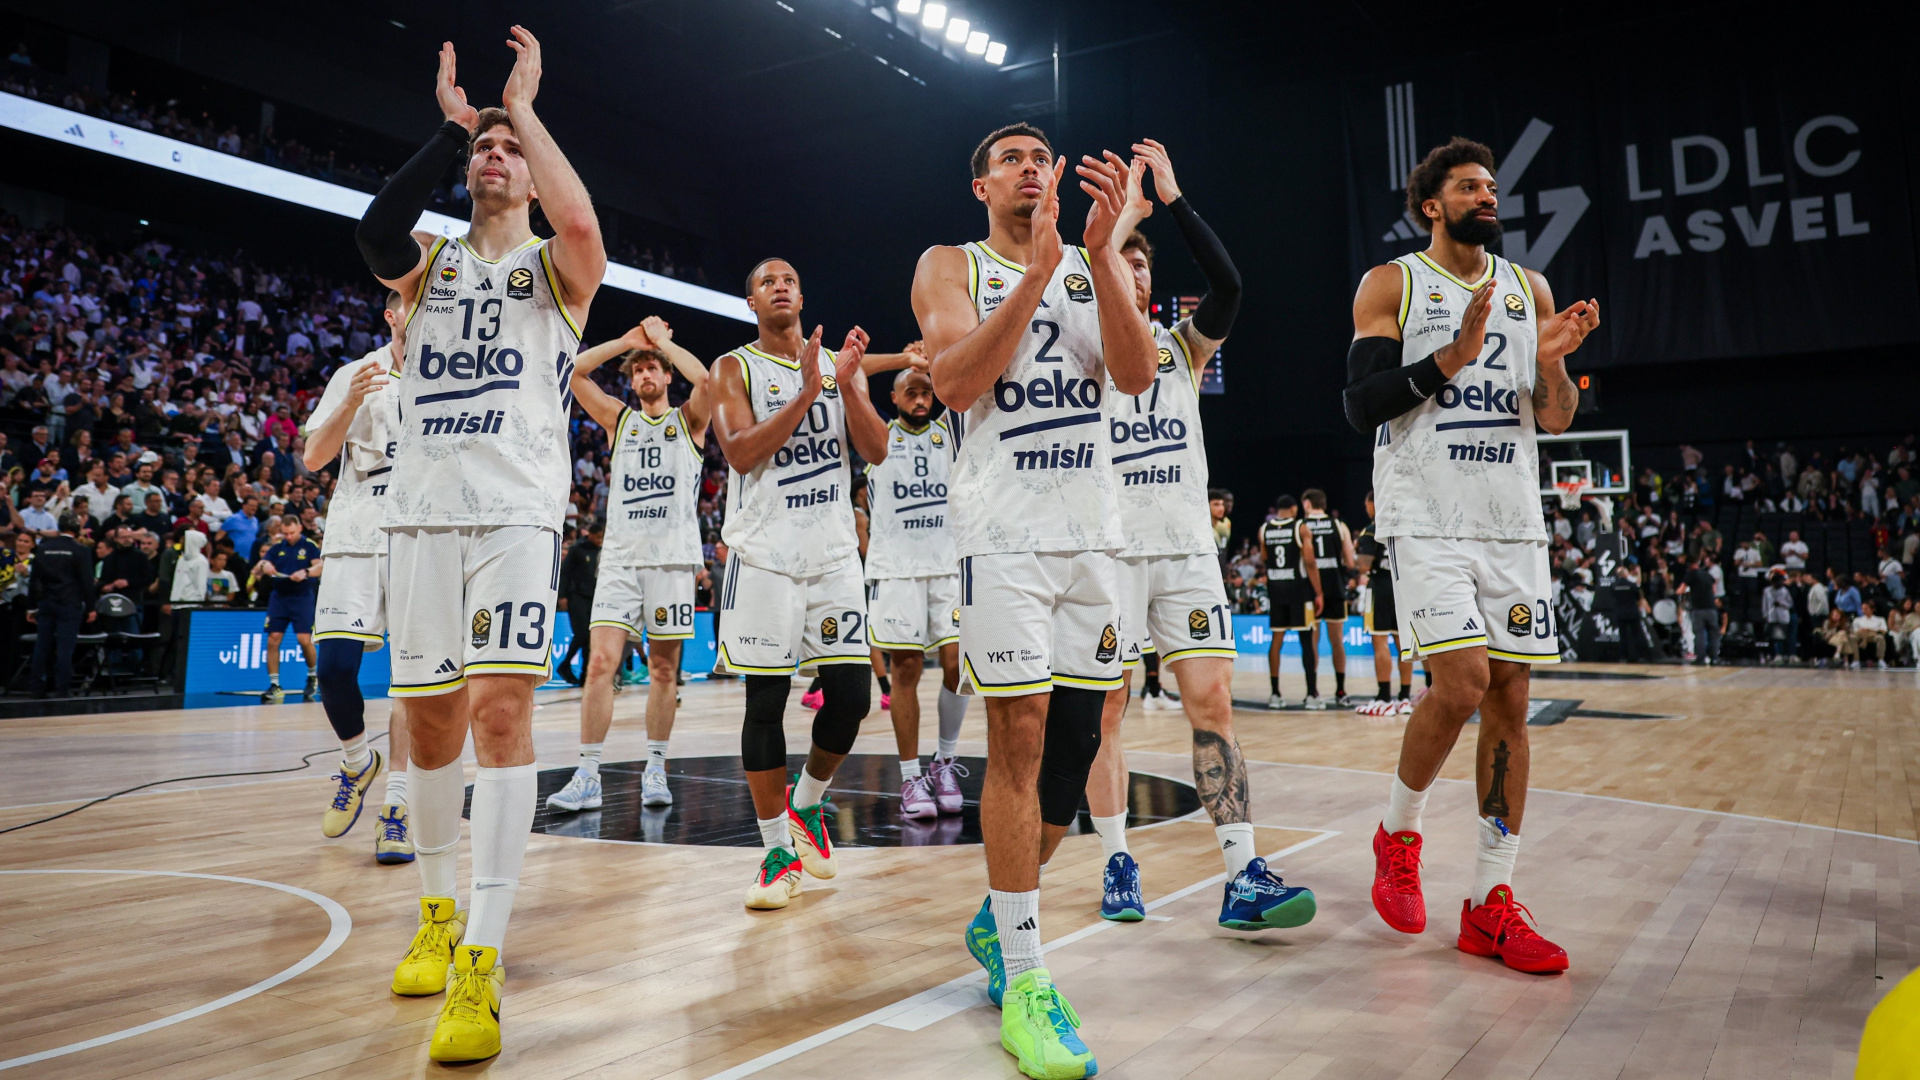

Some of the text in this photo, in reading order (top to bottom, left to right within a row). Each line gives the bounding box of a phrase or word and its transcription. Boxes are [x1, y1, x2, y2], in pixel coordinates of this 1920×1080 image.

[1625, 115, 1861, 201] LDLC
[1634, 192, 1869, 259] ASVEL
[430, 286, 457, 297] beko
[984, 295, 1005, 305] bek
[425, 304, 455, 314] RAMS
[458, 298, 503, 342] 13
[1426, 307, 1450, 316] beko
[1423, 324, 1451, 334] RAMS
[1031, 319, 1063, 362] 2
[419, 344, 524, 380] beko
[994, 369, 1102, 412] beko
[1579, 375, 1590, 389] 0
[767, 399, 786, 408] beko
[421, 409, 505, 435] misli
[1110, 414, 1187, 443] beko
[638, 446, 661, 469] 18
[1013, 442, 1095, 471] misli
[1448, 441, 1516, 464] misli
[914, 456, 929, 477] 8
[1122, 465, 1181, 487] misli
[623, 473, 675, 492] beko
[893, 480, 947, 500] beko
[785, 484, 839, 509] misli
[628, 506, 667, 520] misli
[903, 515, 943, 529] misli
[1275, 545, 1286, 569] 3
[1315, 535, 1325, 558] 1
[669, 603, 692, 627] 18
[1412, 609, 1425, 619] YKT
[494, 601, 546, 650] 13
[739, 636, 757, 645] YKT
[987, 650, 1014, 663] YKT
